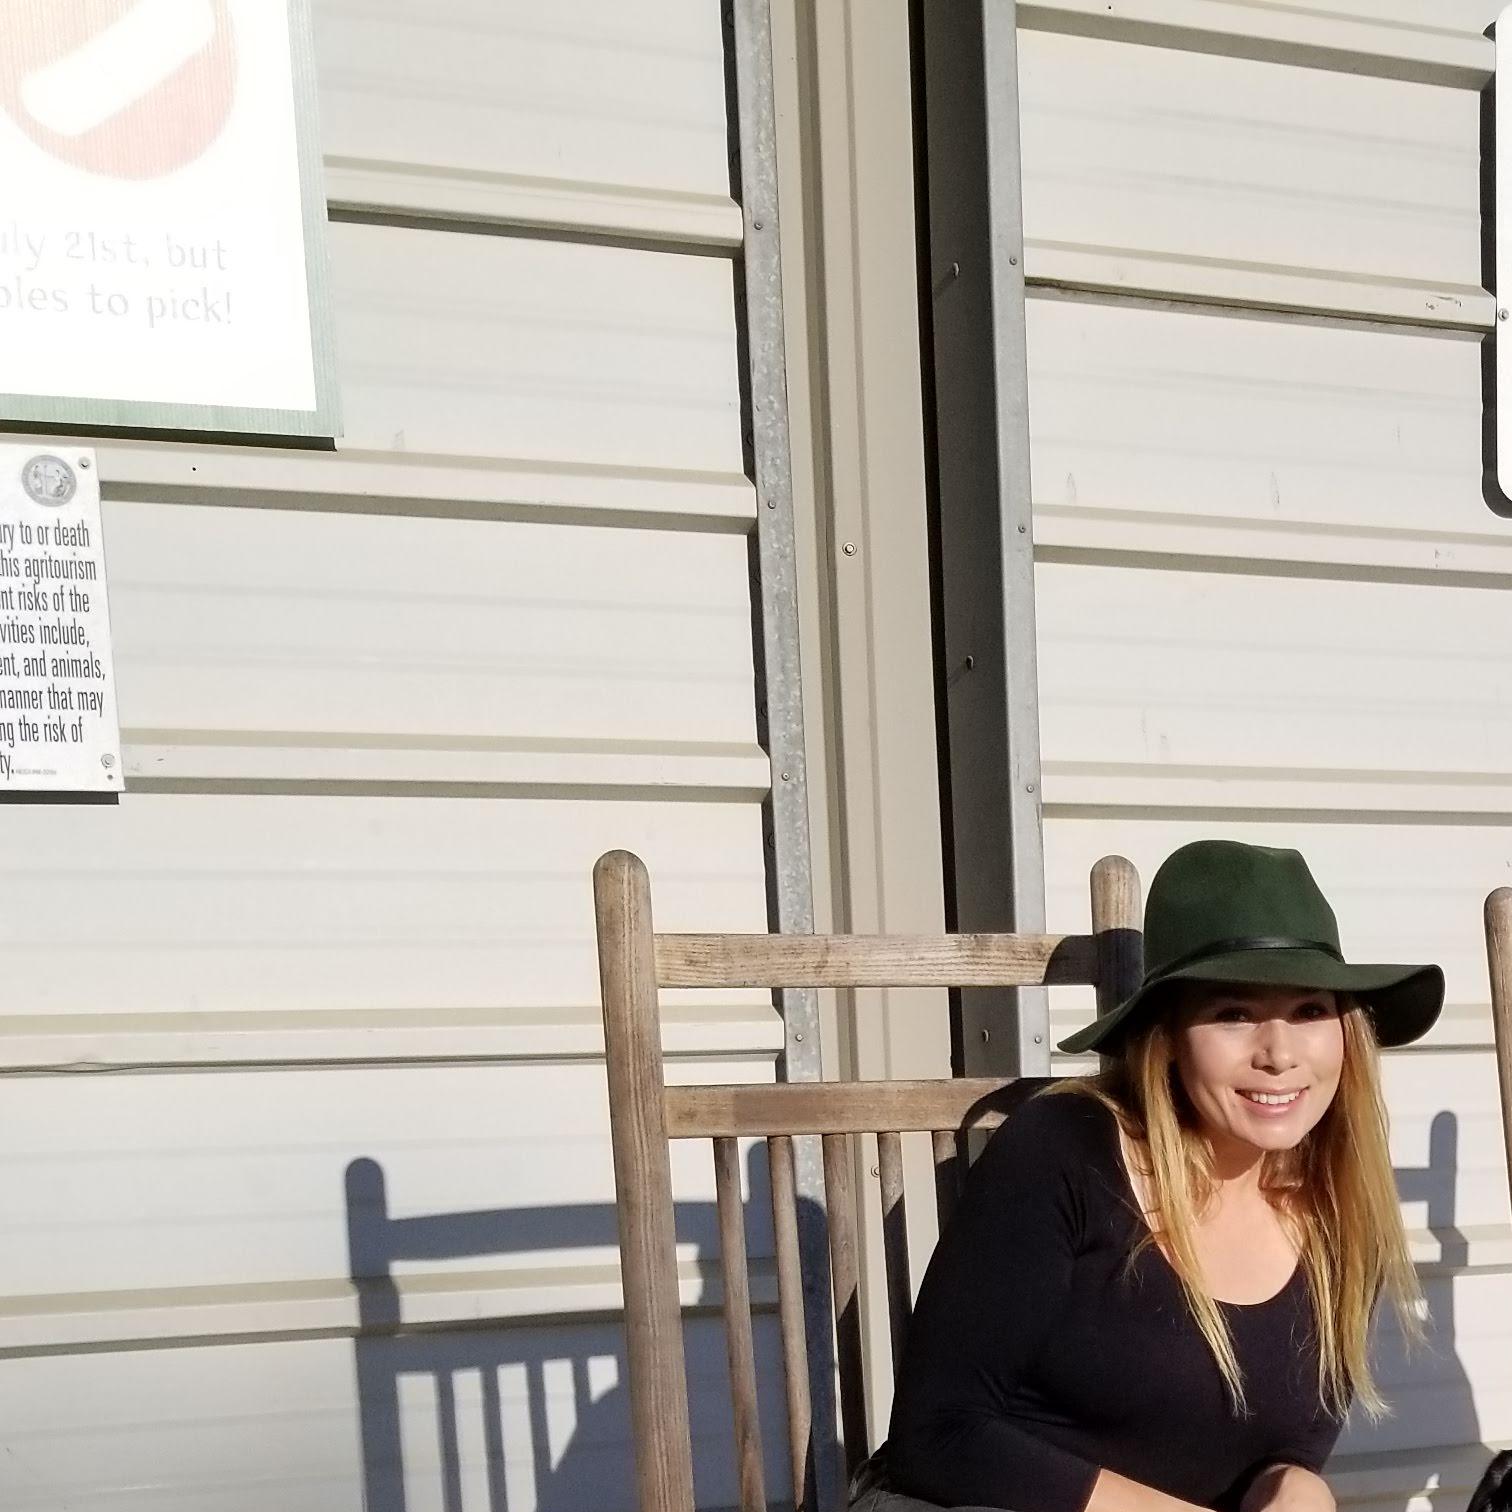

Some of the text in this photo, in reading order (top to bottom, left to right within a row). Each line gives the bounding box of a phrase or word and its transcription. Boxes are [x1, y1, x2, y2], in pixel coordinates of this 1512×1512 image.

[65, 231, 151, 268] 21st,
[166, 232, 229, 271] but
[88, 283, 129, 316] to
[147, 286, 232, 328] pick!
[19, 521, 32, 544] to
[37, 525, 49, 545] or
[54, 518, 90, 547] death
[0, 549, 97, 584] his agritourism
[0, 583, 90, 613] nt risks of the
[39, 617, 90, 648] include,
[23, 650, 47, 677] and
[51, 650, 106, 680] animals,
[47, 683, 73, 710] that
[77, 691, 104, 717] may
[18, 715, 39, 742] the
[43, 715, 67, 742] risk
[71, 716, 83, 743] of
